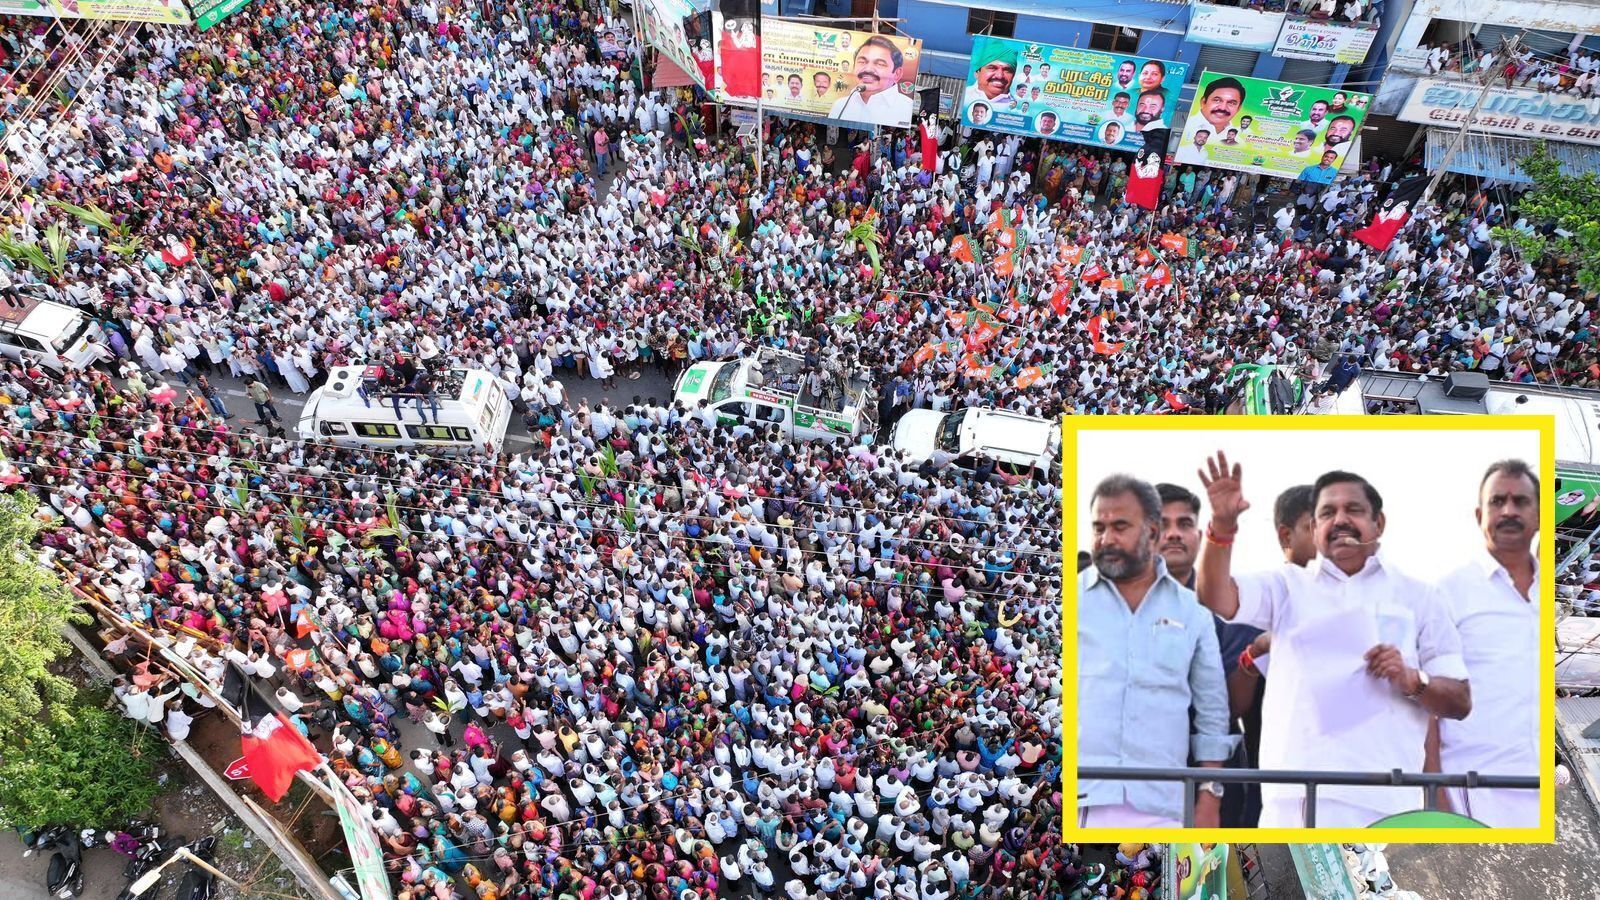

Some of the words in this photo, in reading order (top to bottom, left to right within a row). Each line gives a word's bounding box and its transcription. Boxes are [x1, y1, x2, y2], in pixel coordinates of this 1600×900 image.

[1060, 68, 1113, 88] புரட்சித்
[1043, 81, 1110, 101] தமிழரே!
[1522, 121, 1535, 131] &
[752, 392, 776, 402] NEWS
